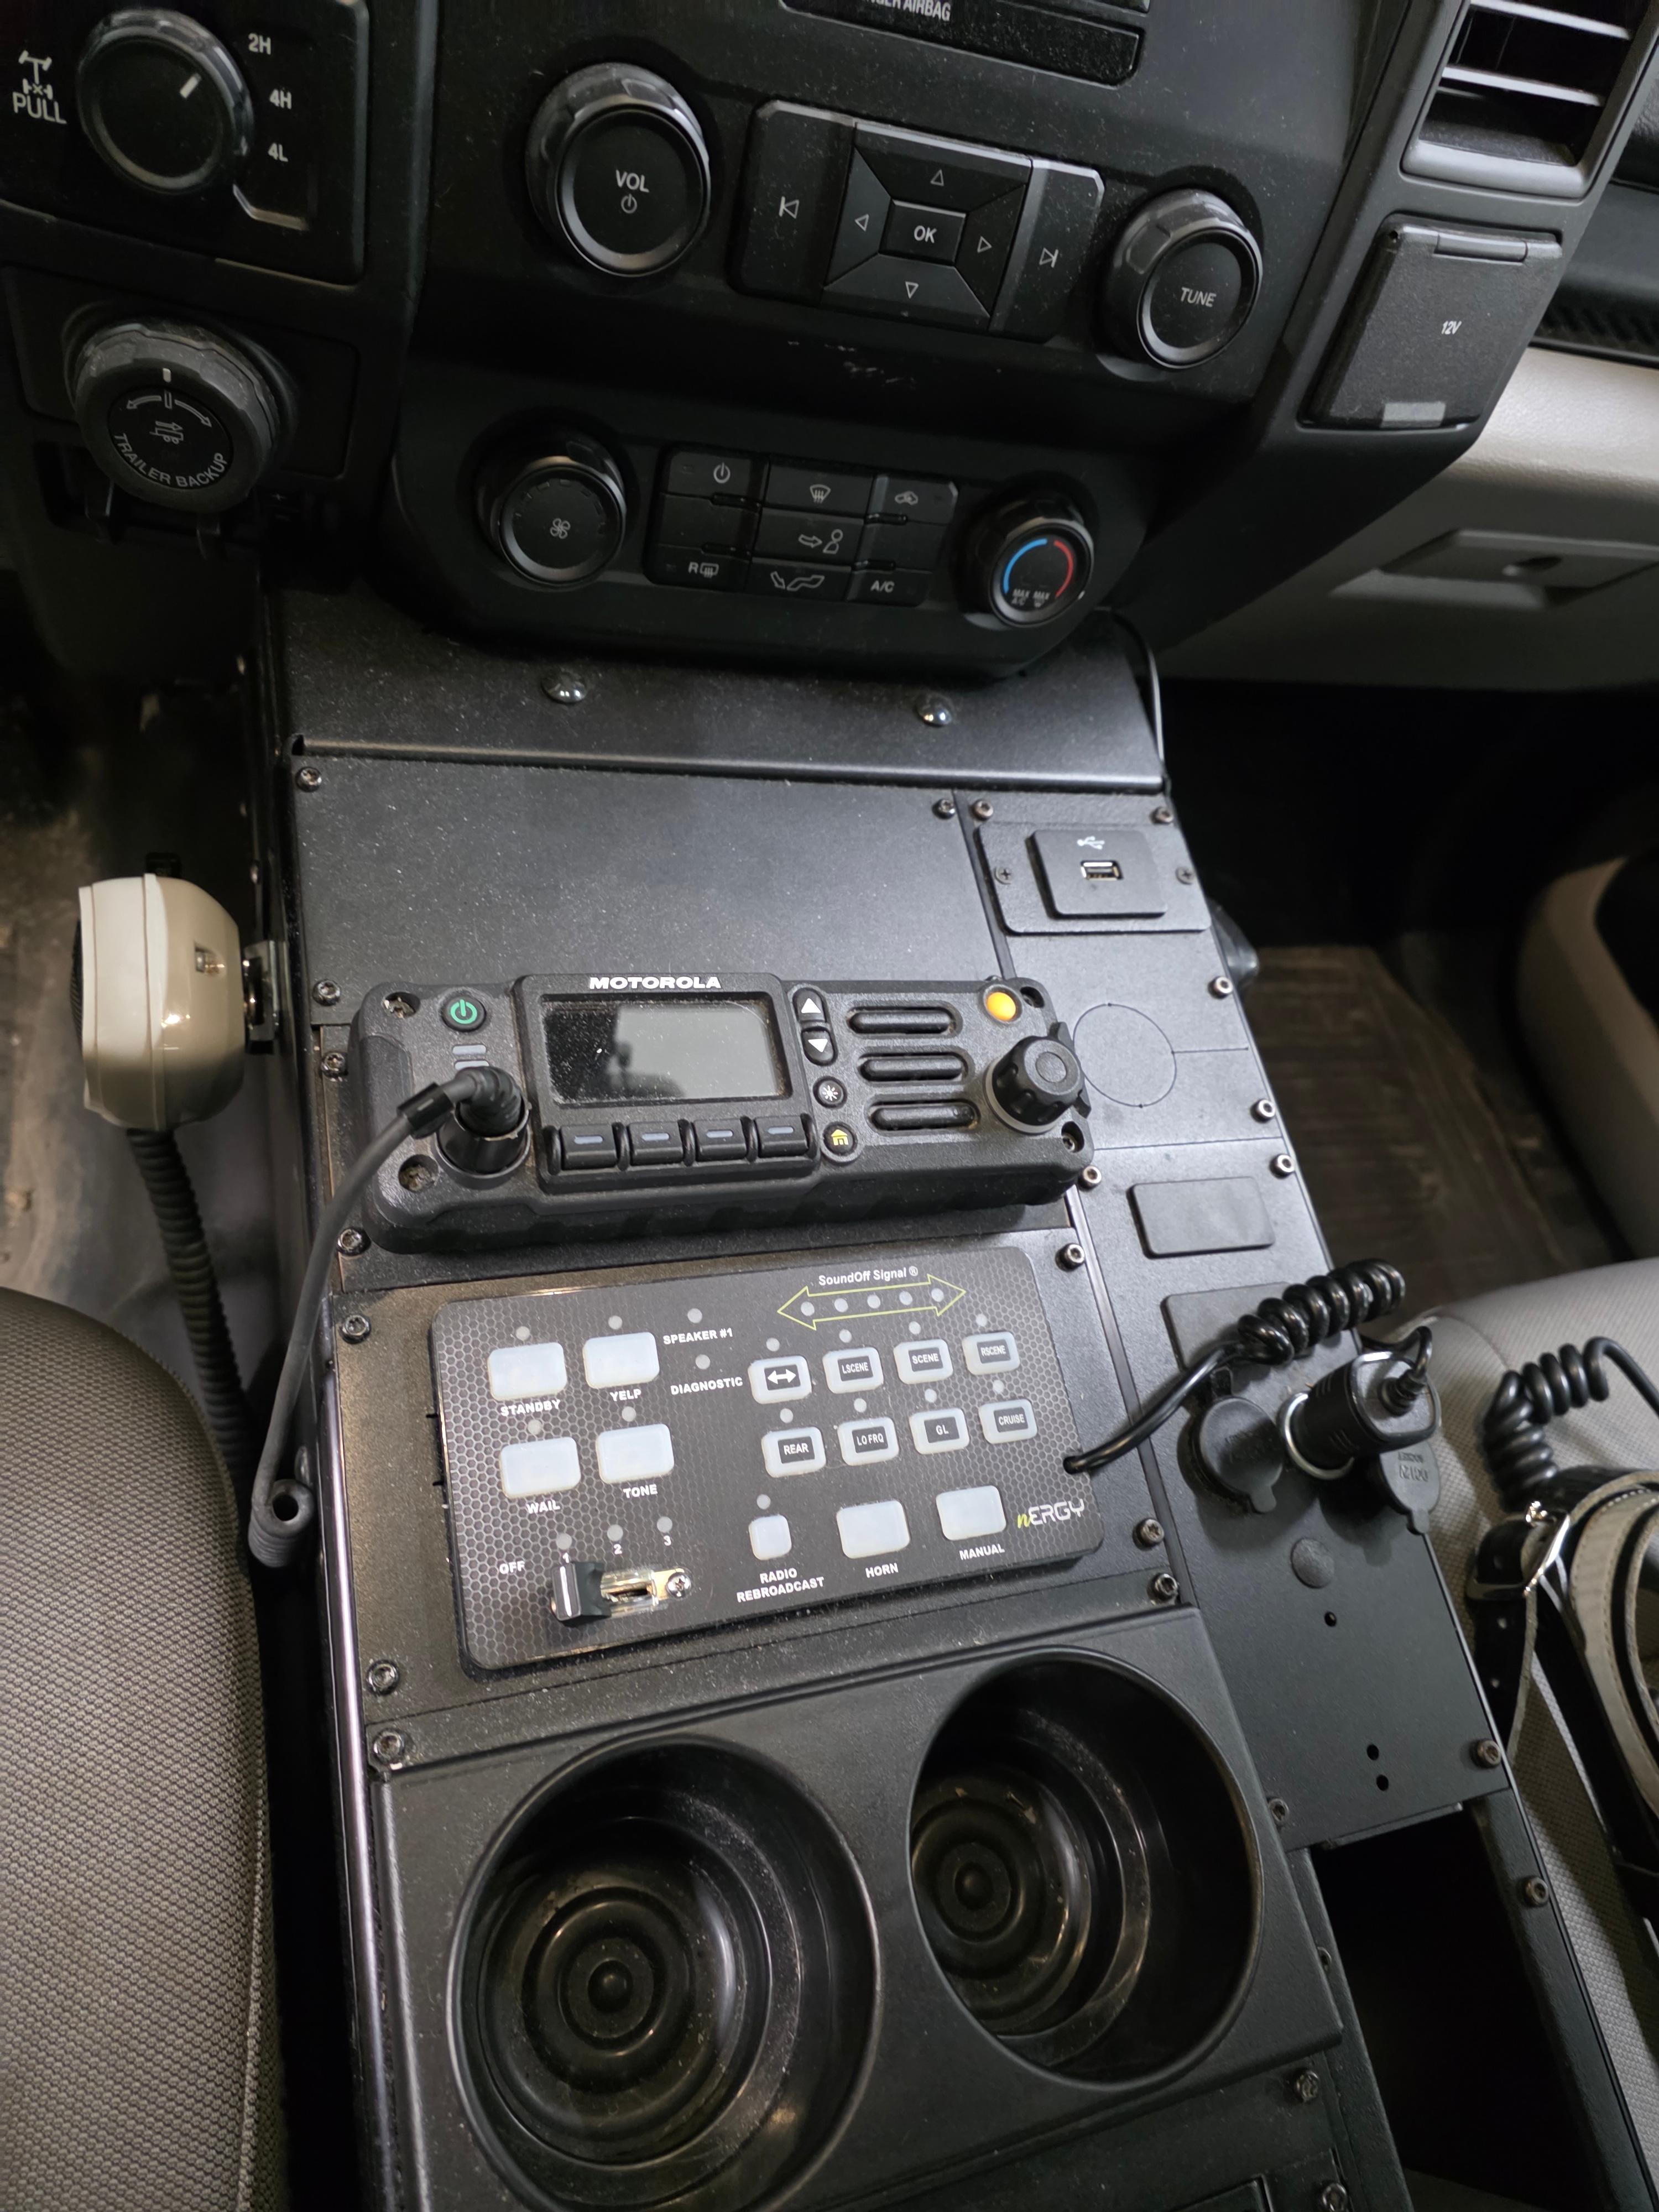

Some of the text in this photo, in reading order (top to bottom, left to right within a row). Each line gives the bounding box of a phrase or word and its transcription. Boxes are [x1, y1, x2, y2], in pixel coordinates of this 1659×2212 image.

[903, 0, 951, 22] AIRBAG
[248, 33, 271, 55] 2H
[270, 89, 291, 109] 4H
[13, 92, 66, 124] PULL
[268, 143, 288, 162] 4L
[615, 170, 649, 193] VOL
[914, 225, 937, 244] OK
[1180, 287, 1217, 307] TUNE
[1441, 321, 1462, 335] 12V
[114, 433, 226, 488] TRAILER BACKUP
[688, 562, 698, 574] R
[871, 580, 895, 593] A/C
[589, 976, 721, 989] MOTOROLA
[818, 1270, 871, 1286] SoundOff
[873, 1267, 907, 1281] Signal
[663, 1328, 733, 1345] SPEAKER #1
[911, 1353, 940, 1364] SCENE
[980, 1344, 1006, 1357] RSCENE
[842, 1361, 869, 1374] LSCENE
[670, 1376, 743, 1395] DIAGNOSTIC
[610, 1389, 641, 1402] YELP
[500, 1399, 561, 1417] STANDBY
[998, 1413, 1026, 1426] CRUISE
[936, 1424, 950, 1436] GL
[783, 1442, 810, 1455] REAR
[623, 1484, 658, 1499] TONE
[526, 1501, 560, 1515] WAIL
[1018, 1498, 1085, 1529] nERGY
[614, 1544, 623, 1554] 2
[664, 1535, 672, 1547] 3
[562, 1552, 570, 1563] 1
[959, 1543, 1005, 1561] MANUAL
[499, 1561, 526, 1575] OFF
[759, 1568, 798, 1584] RADIO
[865, 1562, 899, 1579] HORN
[736, 1577, 825, 1604] REBROADCAST
